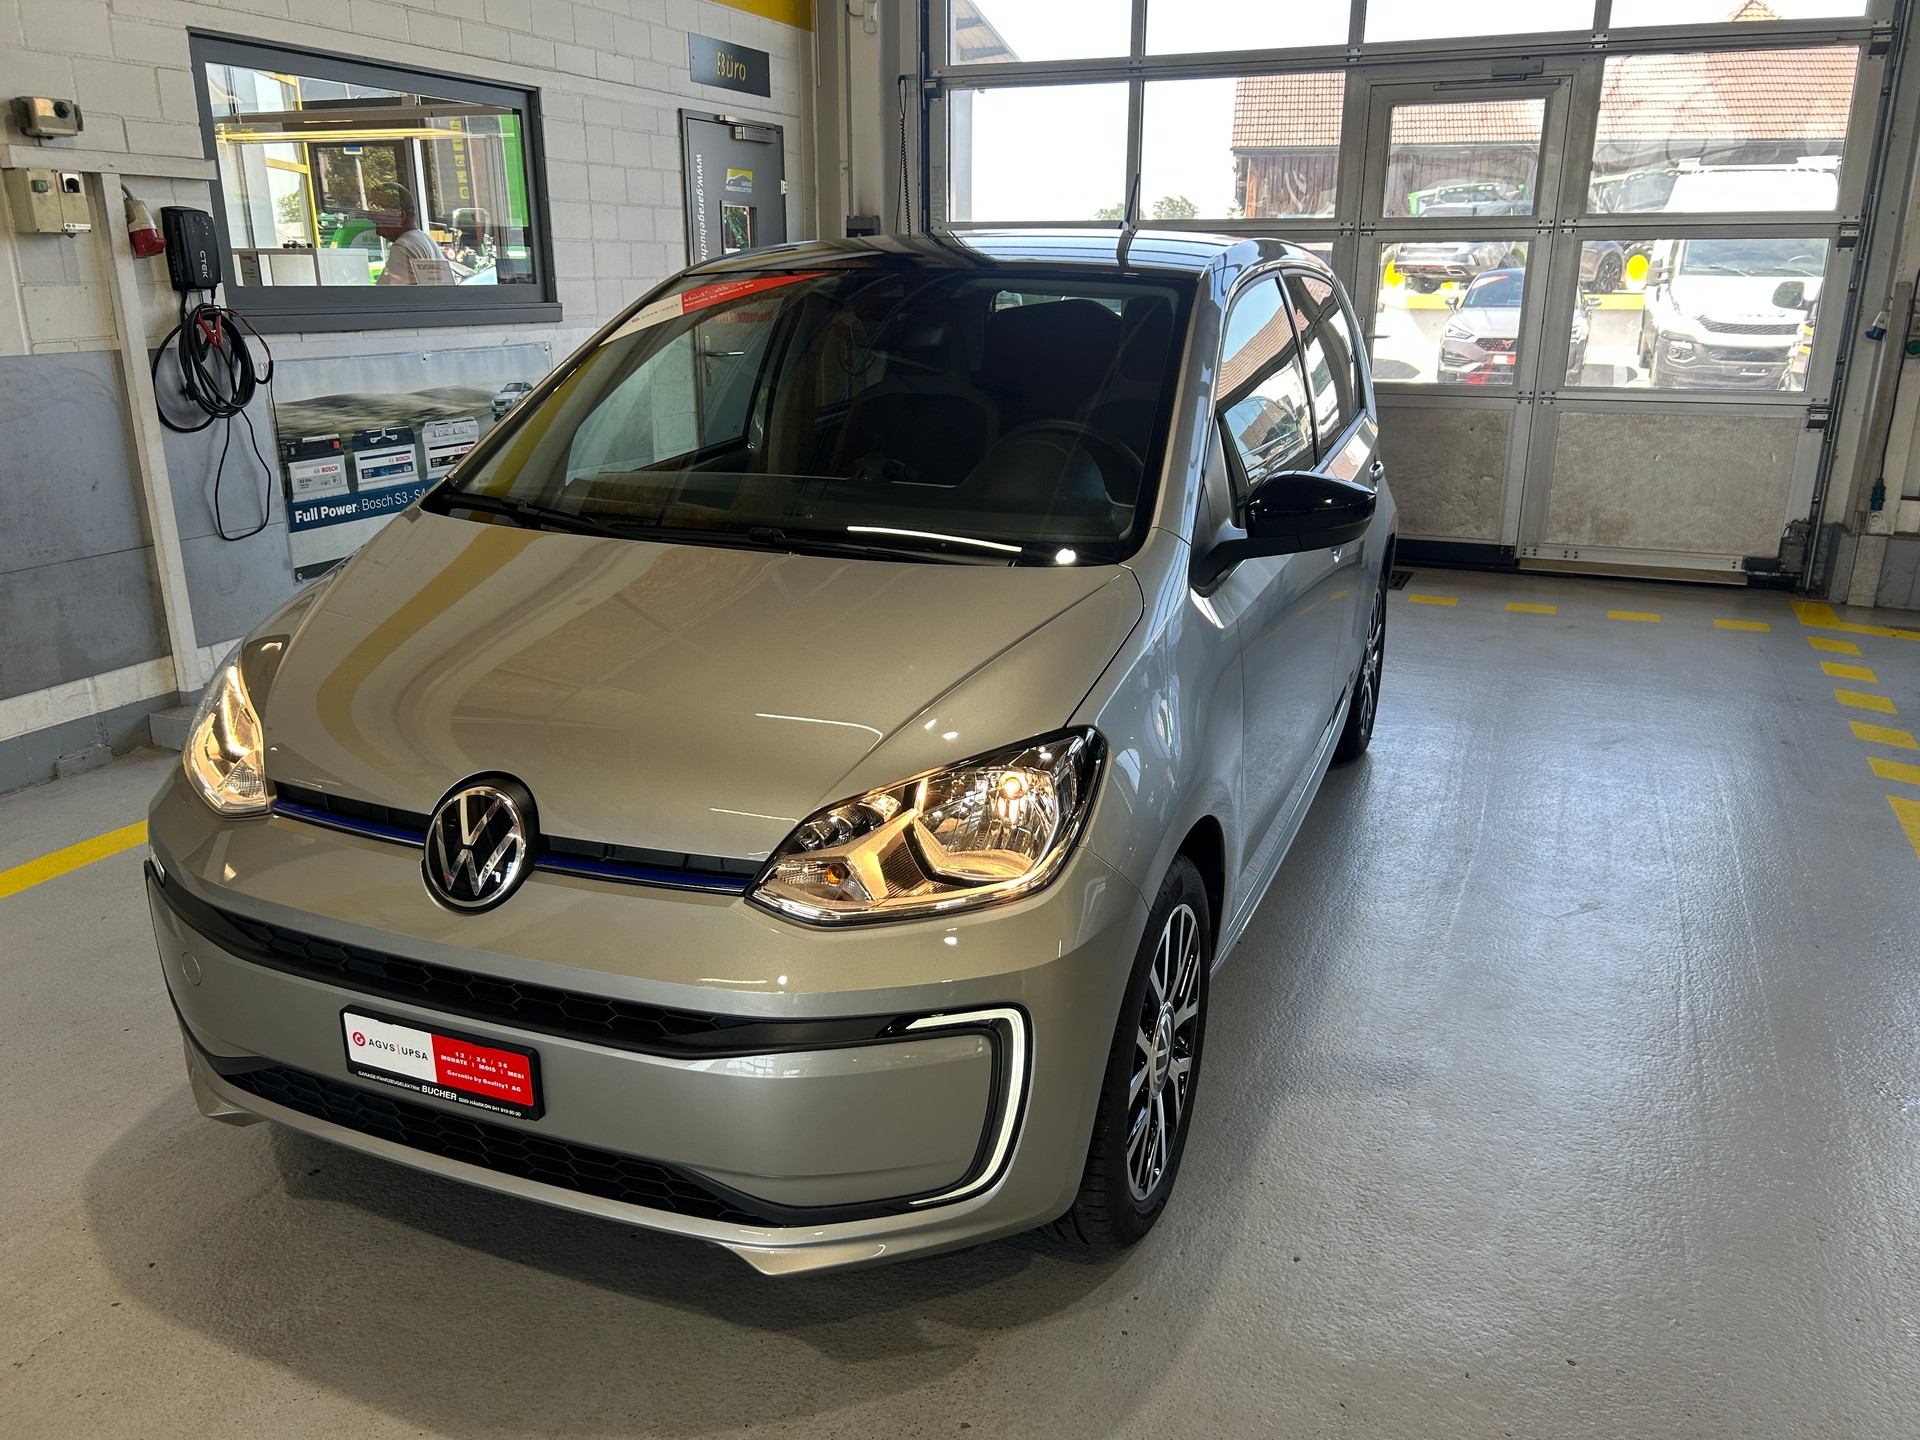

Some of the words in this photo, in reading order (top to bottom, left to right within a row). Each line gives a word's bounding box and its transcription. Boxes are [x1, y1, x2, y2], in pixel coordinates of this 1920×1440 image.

[717, 51, 747, 82] Büro
[200, 250, 209, 279] CTEK
[321, 465, 339, 473] BOSCH
[395, 455, 411, 463] BOSCH
[295, 506, 318, 524] Full
[321, 502, 360, 519] Power:
[361, 494, 394, 511] Bosch
[395, 491, 408, 505] S3
[368, 1038, 396, 1052] AGVS
[401, 1047, 429, 1061] UPSA
[455, 1051, 465, 1059] 12
[440, 1054, 468, 1066] MONATE
[479, 1063, 497, 1073] MOIS
[507, 1070, 524, 1079] MESI
[421, 1084, 457, 1101] BUCHER
[446, 1069, 473, 1081] Garantie
[473, 1076, 482, 1084] by
[511, 1085, 521, 1093] AG
